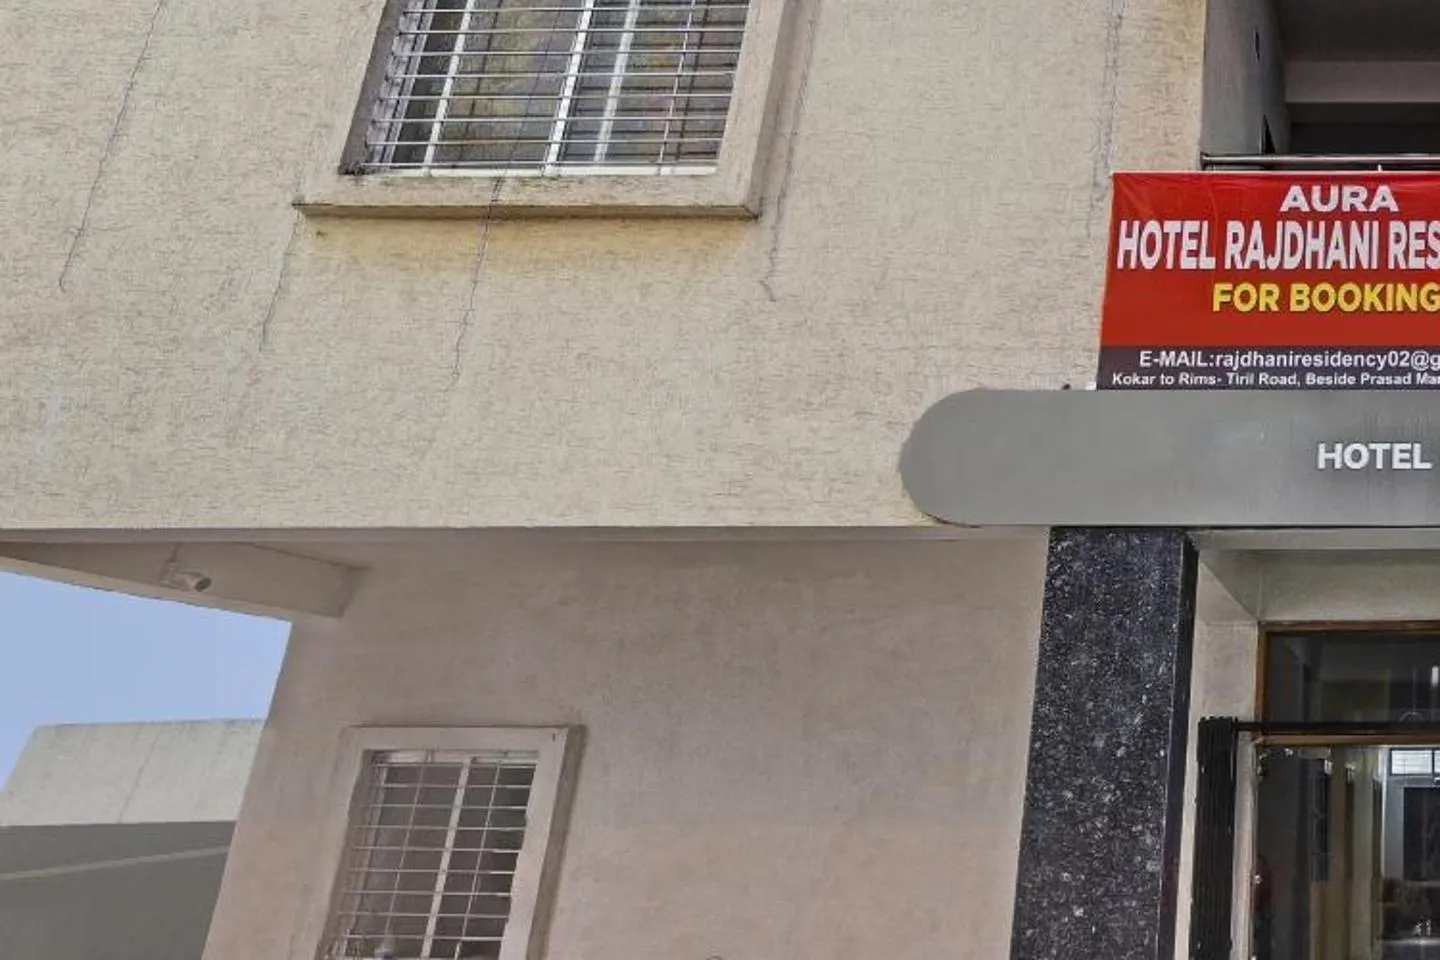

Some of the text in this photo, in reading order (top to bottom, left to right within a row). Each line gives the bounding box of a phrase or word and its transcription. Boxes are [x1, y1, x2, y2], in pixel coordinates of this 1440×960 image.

[1280, 185, 1398, 212] AURA
[1117, 220, 1216, 270] HOTEL
[1225, 220, 1379, 270] RAJDHANI
[1213, 284, 1279, 312] FOR
[1112, 372, 1155, 386] Kokar
[1160, 373, 1175, 386] to
[1259, 372, 1301, 387] Road,
[1305, 372, 1356, 386] Beside
[1361, 372, 1412, 386] Prasad
[1317, 443, 1432, 470] HOTEL
